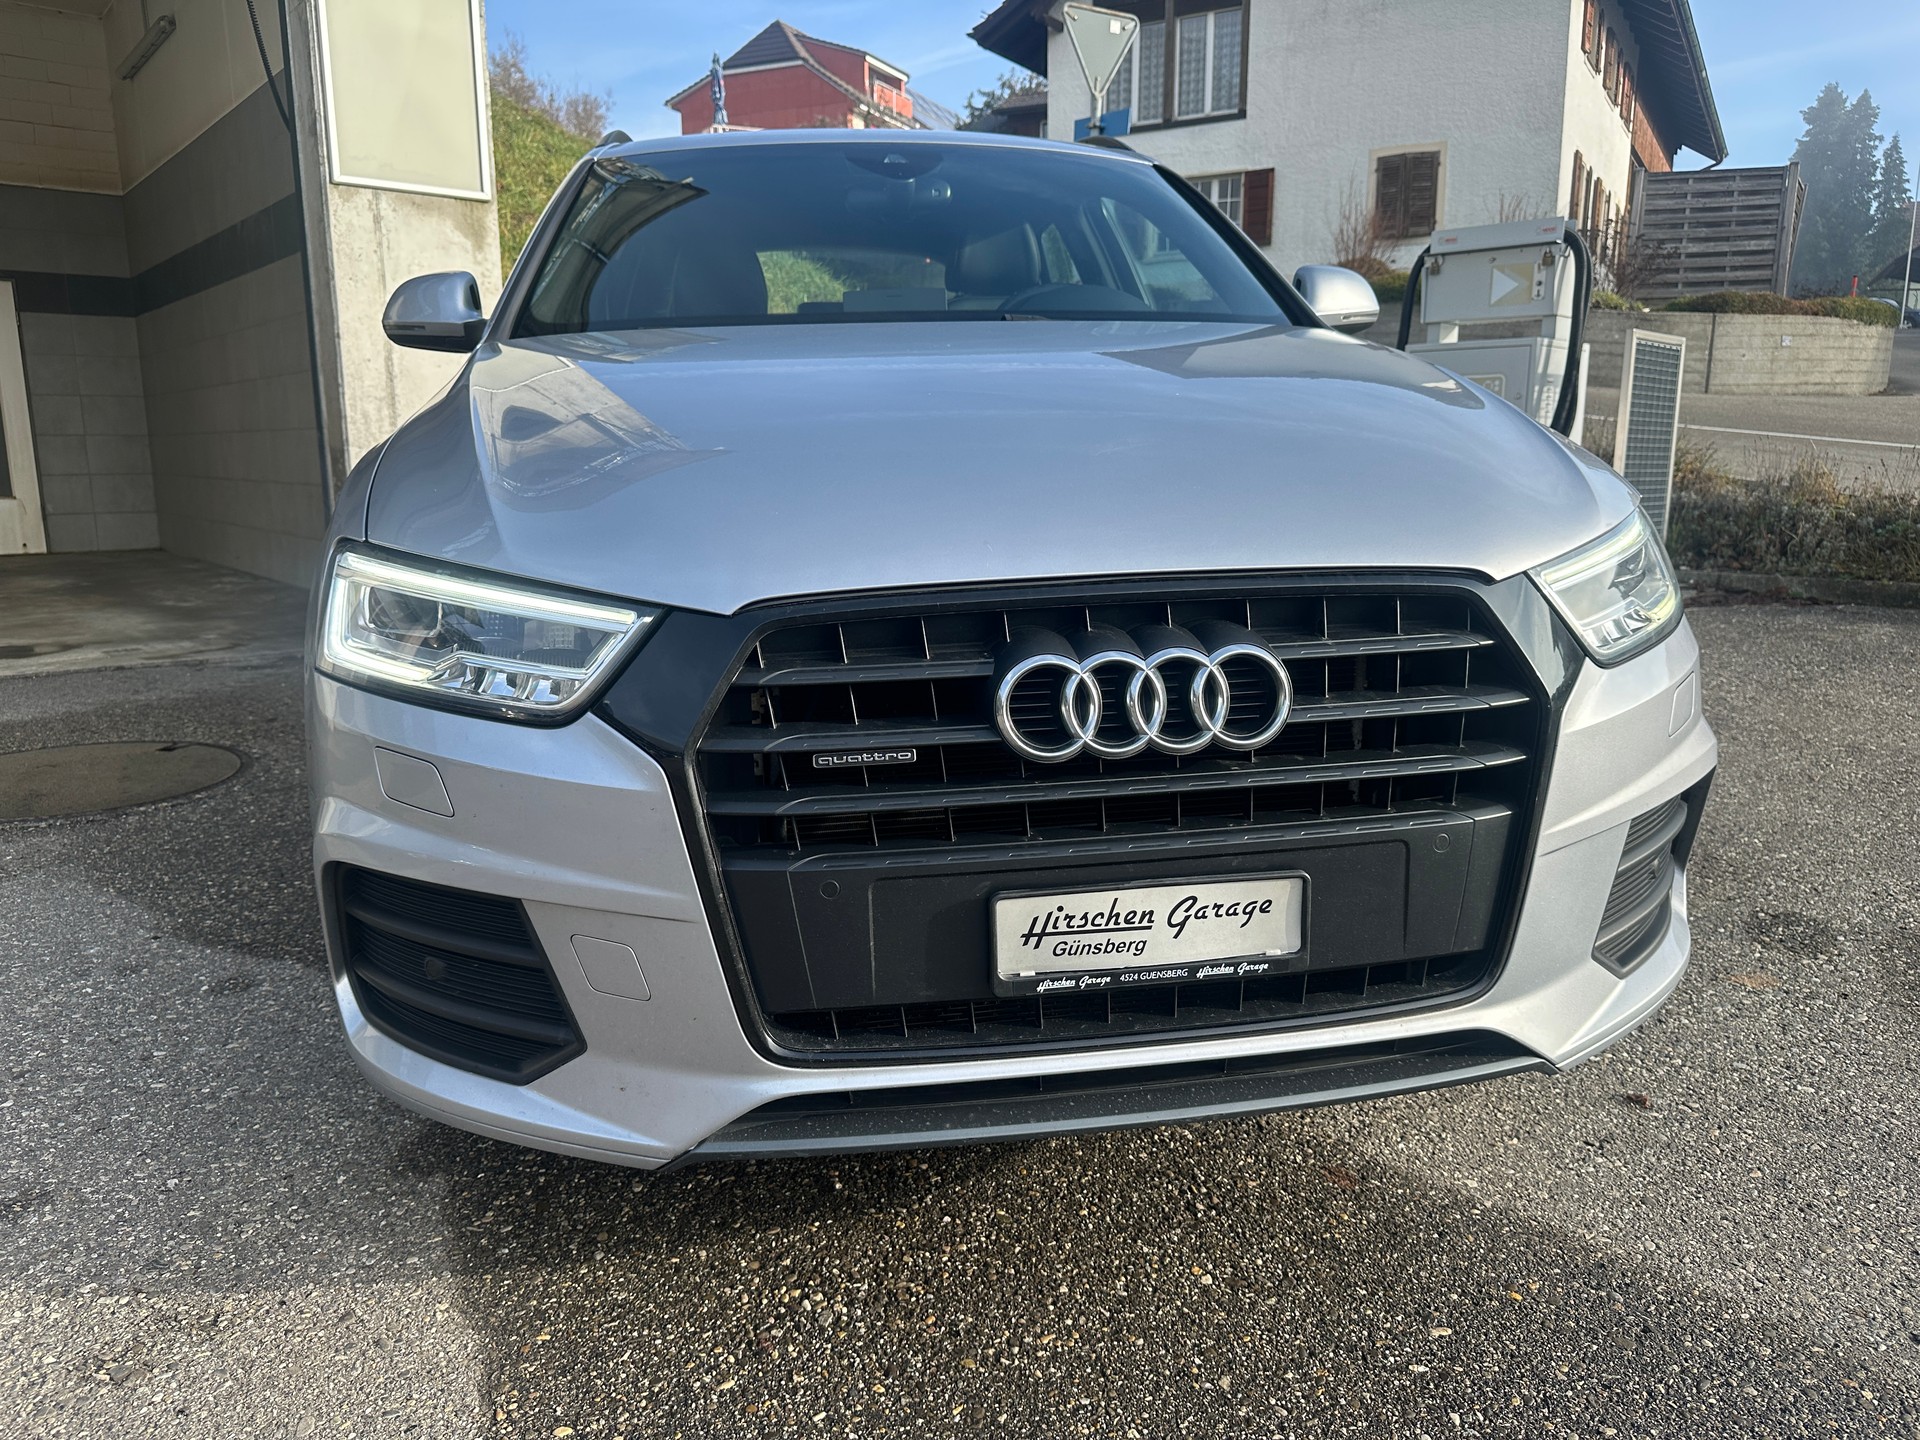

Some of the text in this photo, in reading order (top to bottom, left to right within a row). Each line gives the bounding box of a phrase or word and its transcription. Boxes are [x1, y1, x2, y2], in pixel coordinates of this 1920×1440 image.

[817, 752, 912, 766] quattro
[1020, 895, 1274, 950] Hirschen Garage
[1052, 938, 1148, 957] Günsberg
[1036, 962, 1269, 994] Hirschen Garage 4524 GUENSBERG Hirschen Garage
